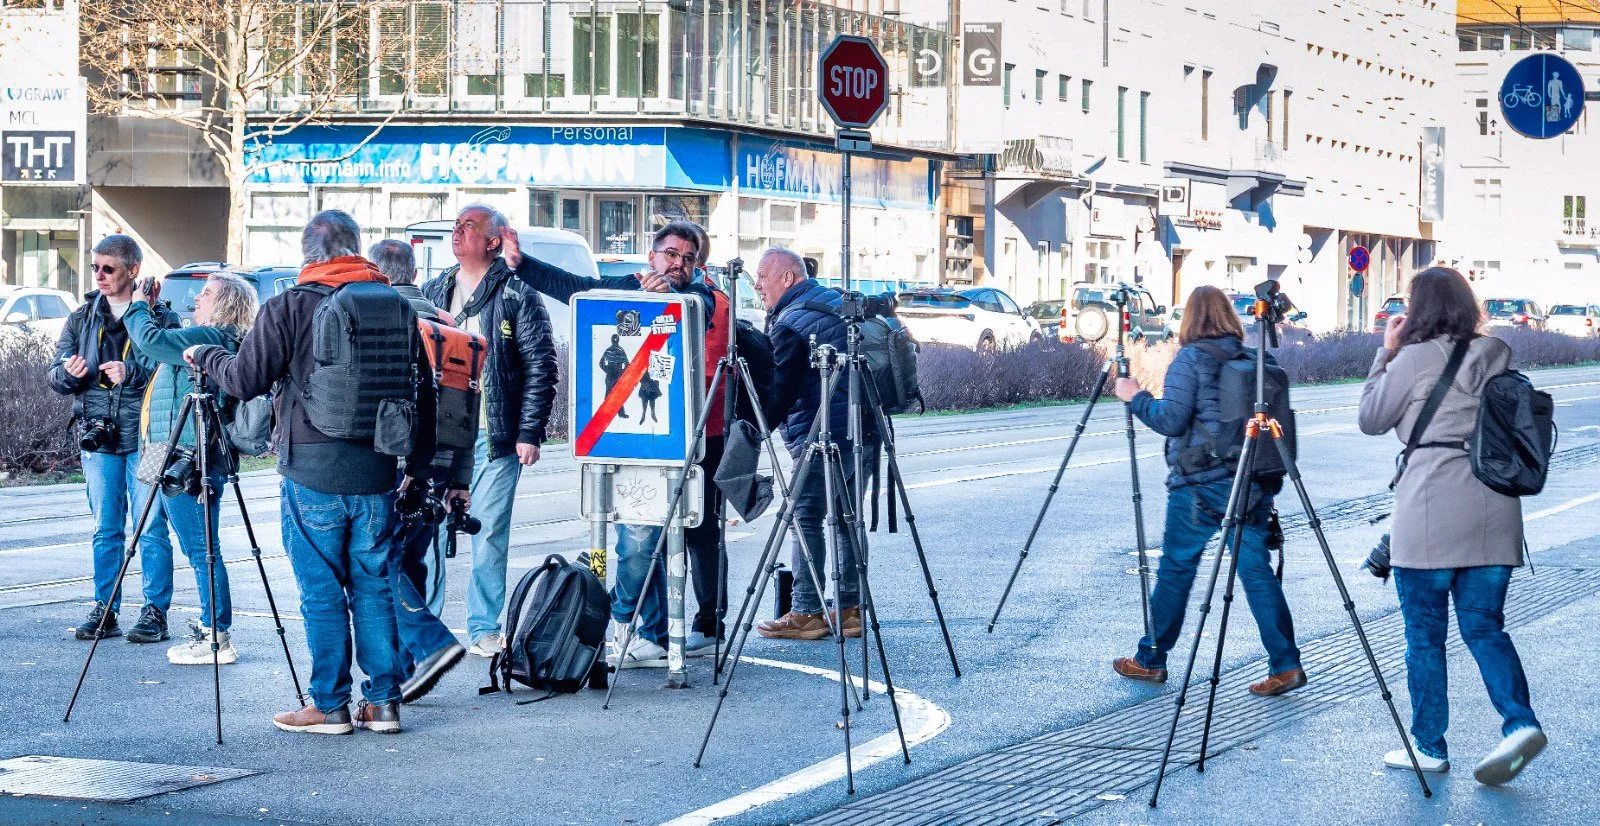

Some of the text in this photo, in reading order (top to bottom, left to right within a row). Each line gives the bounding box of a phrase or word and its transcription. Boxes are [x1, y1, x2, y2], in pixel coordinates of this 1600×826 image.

[968, 48, 996, 76] G
[830, 64, 878, 100] STOP
[24, 87, 72, 101] GRAWE
[9, 110, 40, 125] MCL
[551, 126, 633, 140] Personal
[6, 136, 72, 168] THT
